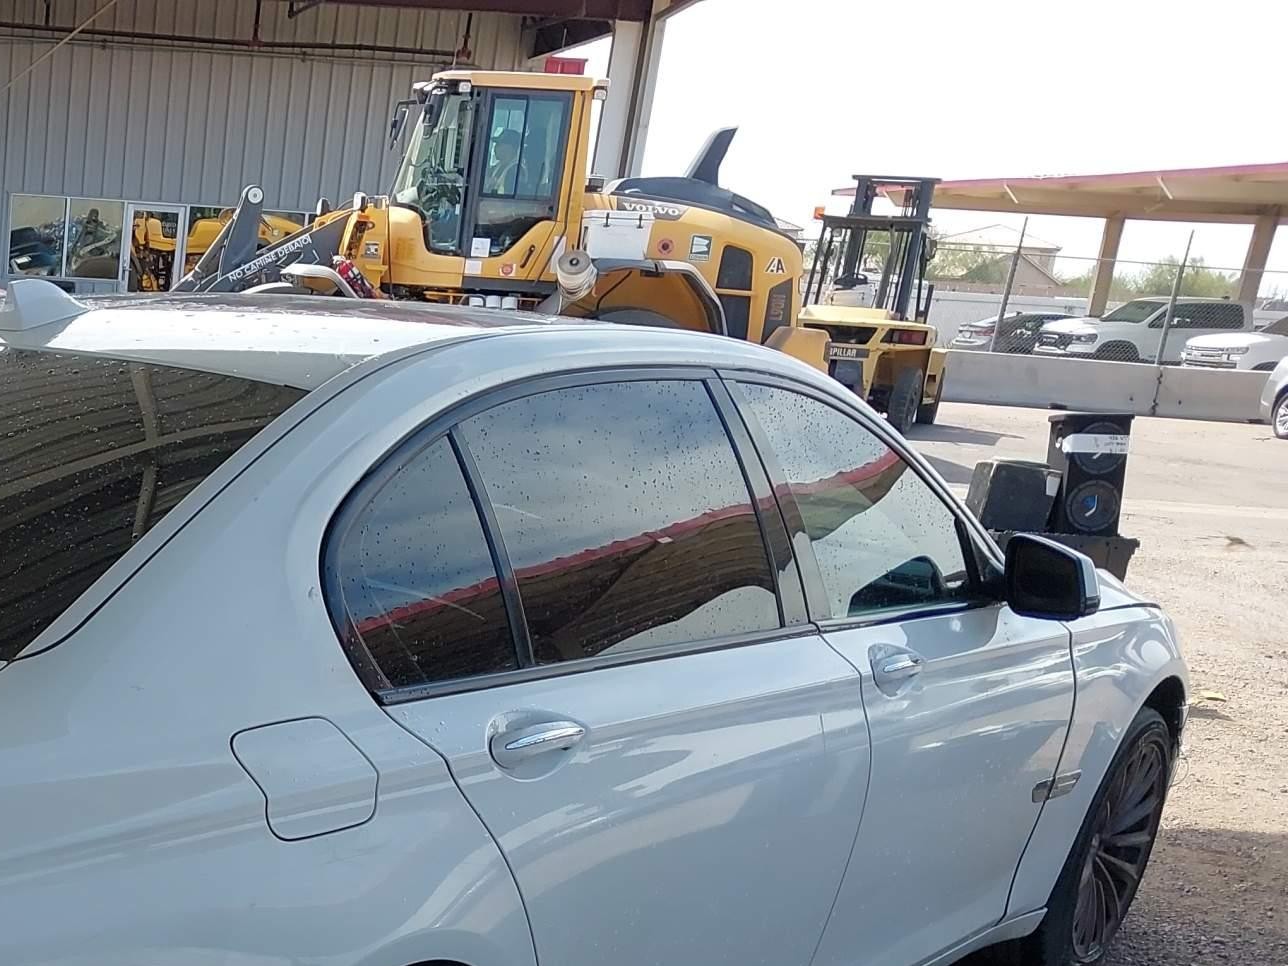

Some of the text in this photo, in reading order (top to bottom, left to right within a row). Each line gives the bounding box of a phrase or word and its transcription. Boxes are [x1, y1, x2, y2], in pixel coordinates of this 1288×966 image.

[623, 202, 680, 216] VOLVO
[228, 235, 309, 282] NO CAMINE DEBAJO
